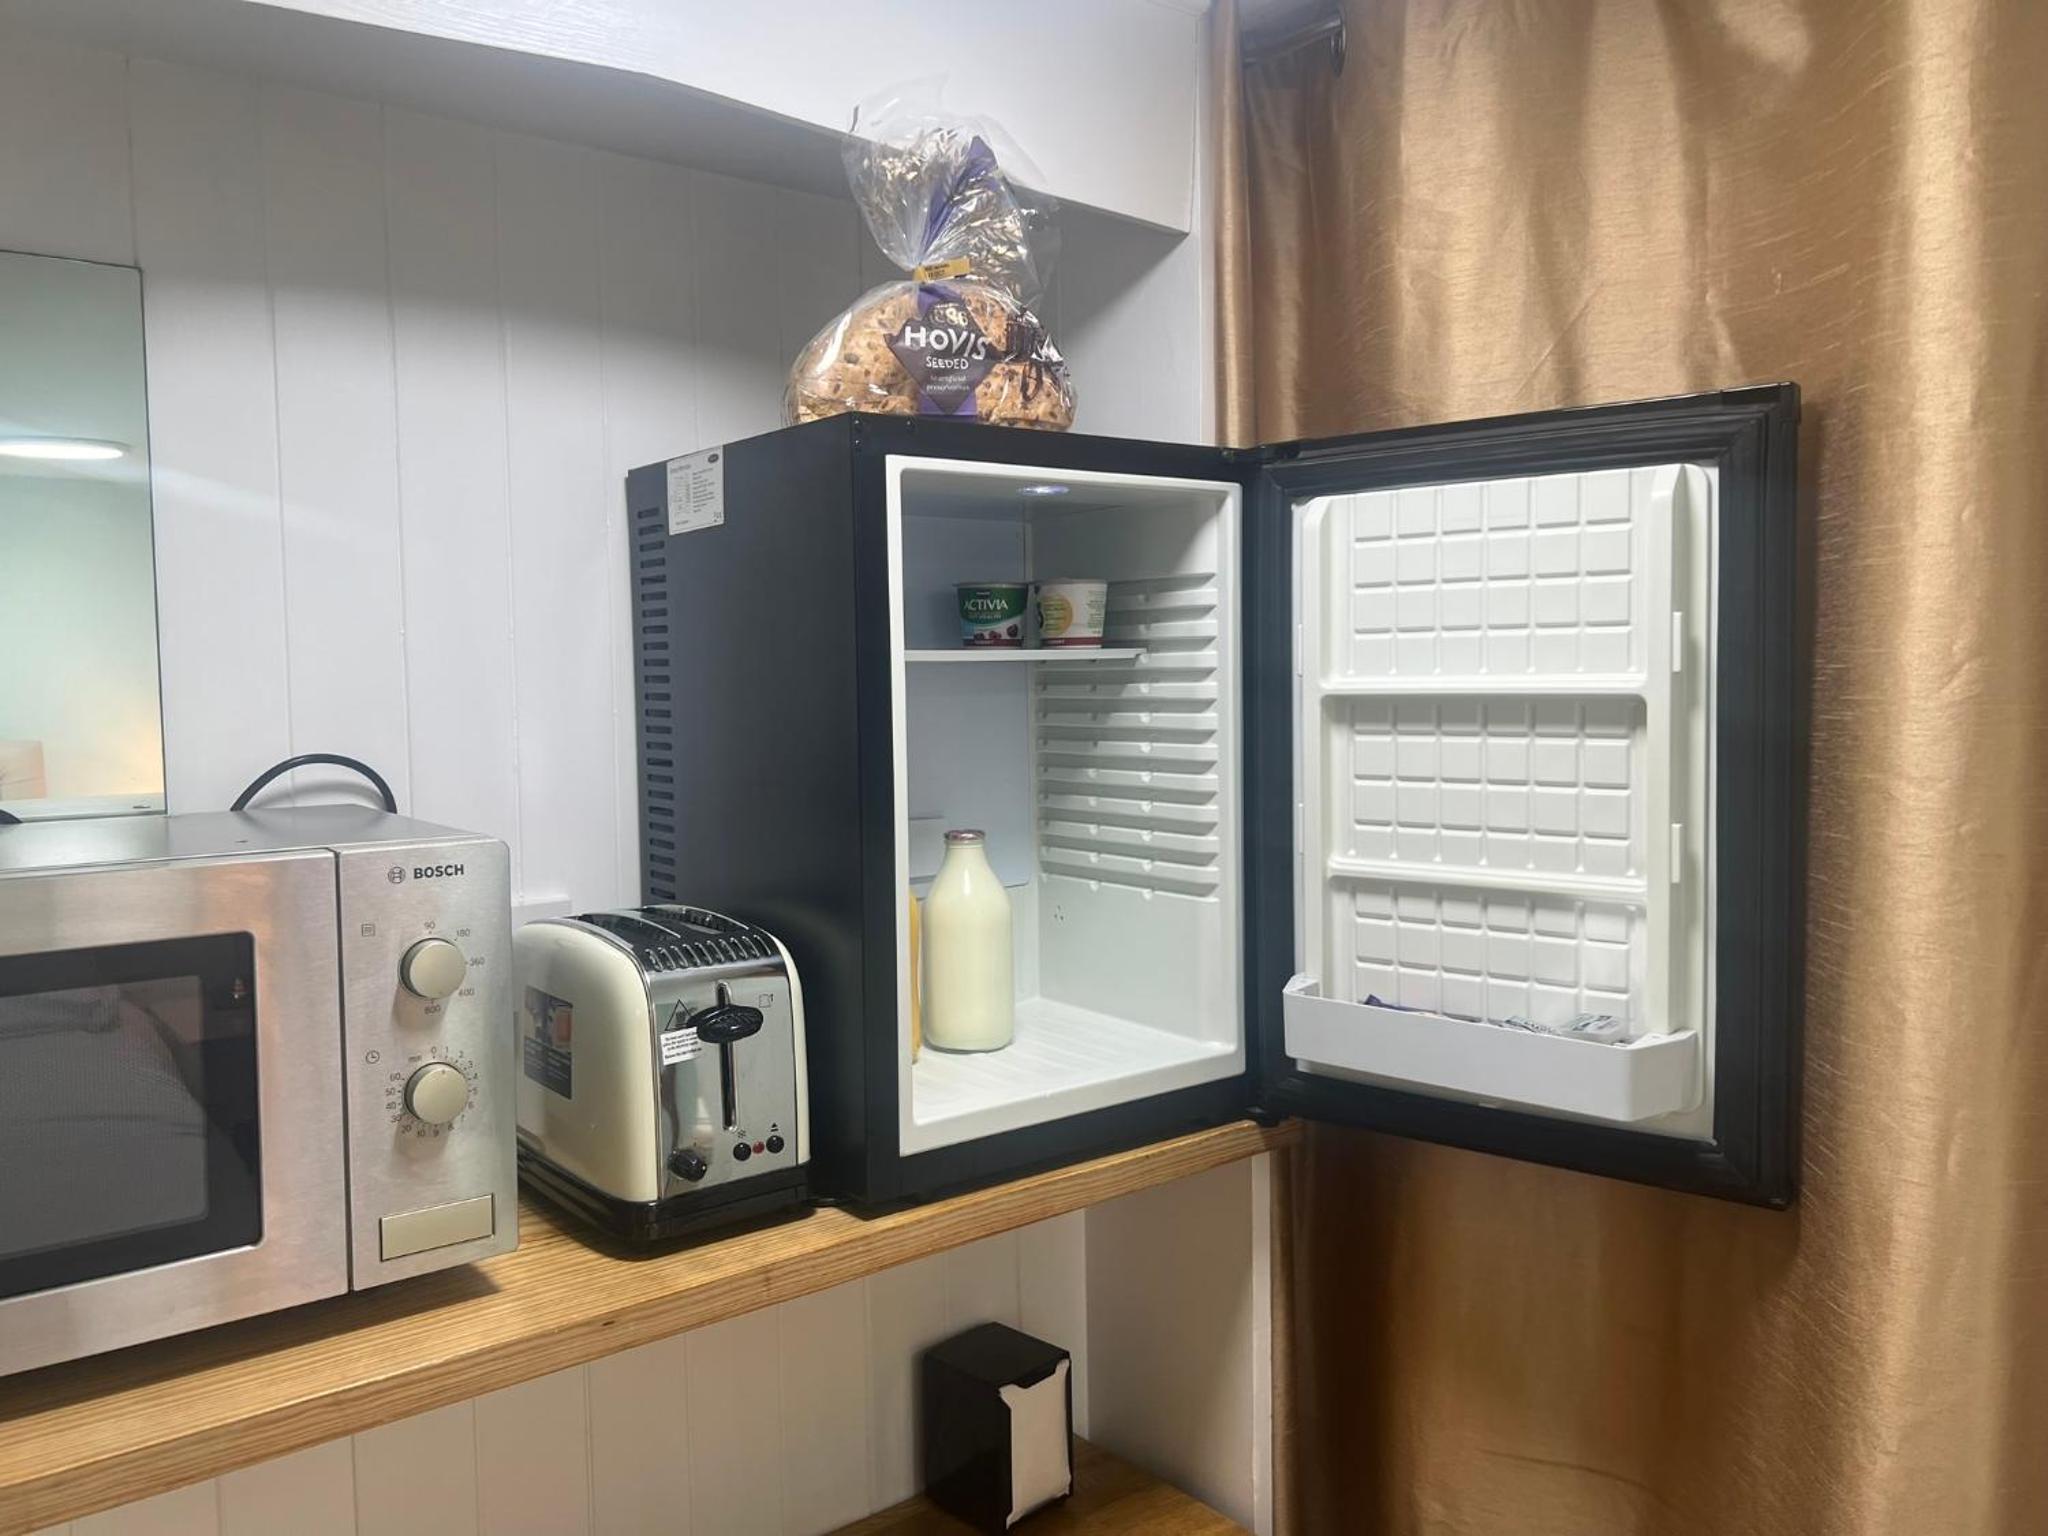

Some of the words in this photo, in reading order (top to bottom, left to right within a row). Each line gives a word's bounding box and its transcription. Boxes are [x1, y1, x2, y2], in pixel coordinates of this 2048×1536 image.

[904, 325, 987, 361] HOVIS
[926, 356, 969, 370] SEEDED
[961, 599, 1009, 611] ACTIVIA
[414, 864, 465, 879] BOSCH
[456, 927, 471, 937] 180
[430, 1046, 437, 1054] 0
